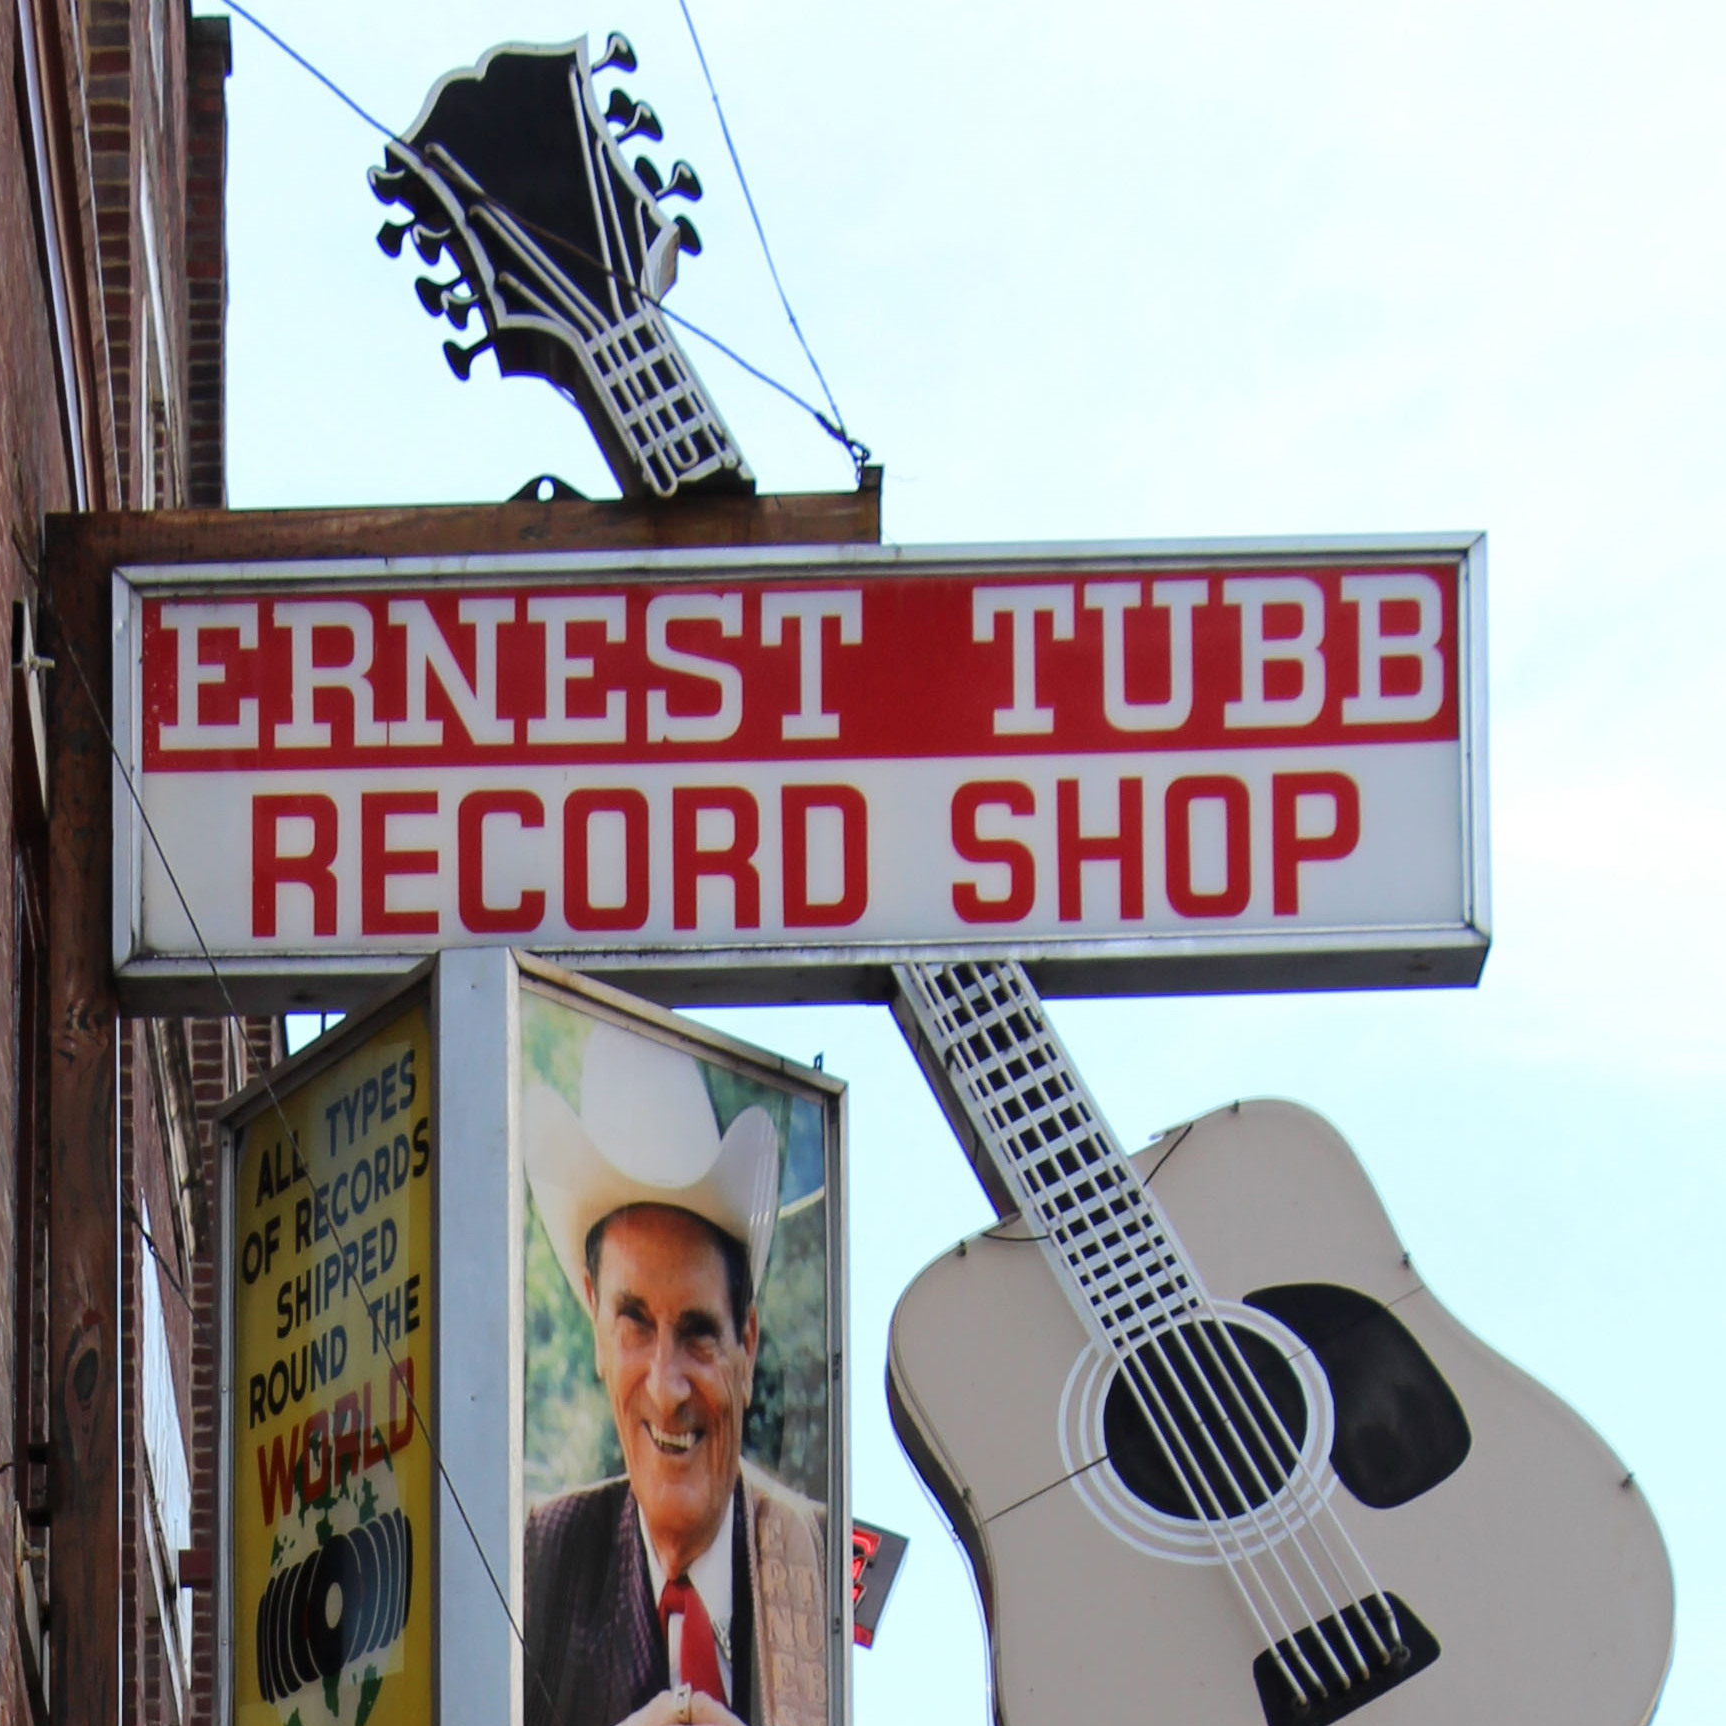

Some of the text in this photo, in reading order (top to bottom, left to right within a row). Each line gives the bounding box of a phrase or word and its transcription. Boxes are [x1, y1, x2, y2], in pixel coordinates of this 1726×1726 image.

[159, 573, 1445, 752] ERNEST TUBB
[250, 771, 1361, 939] RECORD SHOP
[242, 1117, 429, 1284] OF RECORDS
[256, 1049, 416, 1208] ALL TYPES
[250, 1274, 421, 1429] ROUND THE
[277, 1218, 398, 1339] SHIPPED
[257, 1357, 415, 1527] WORLD
